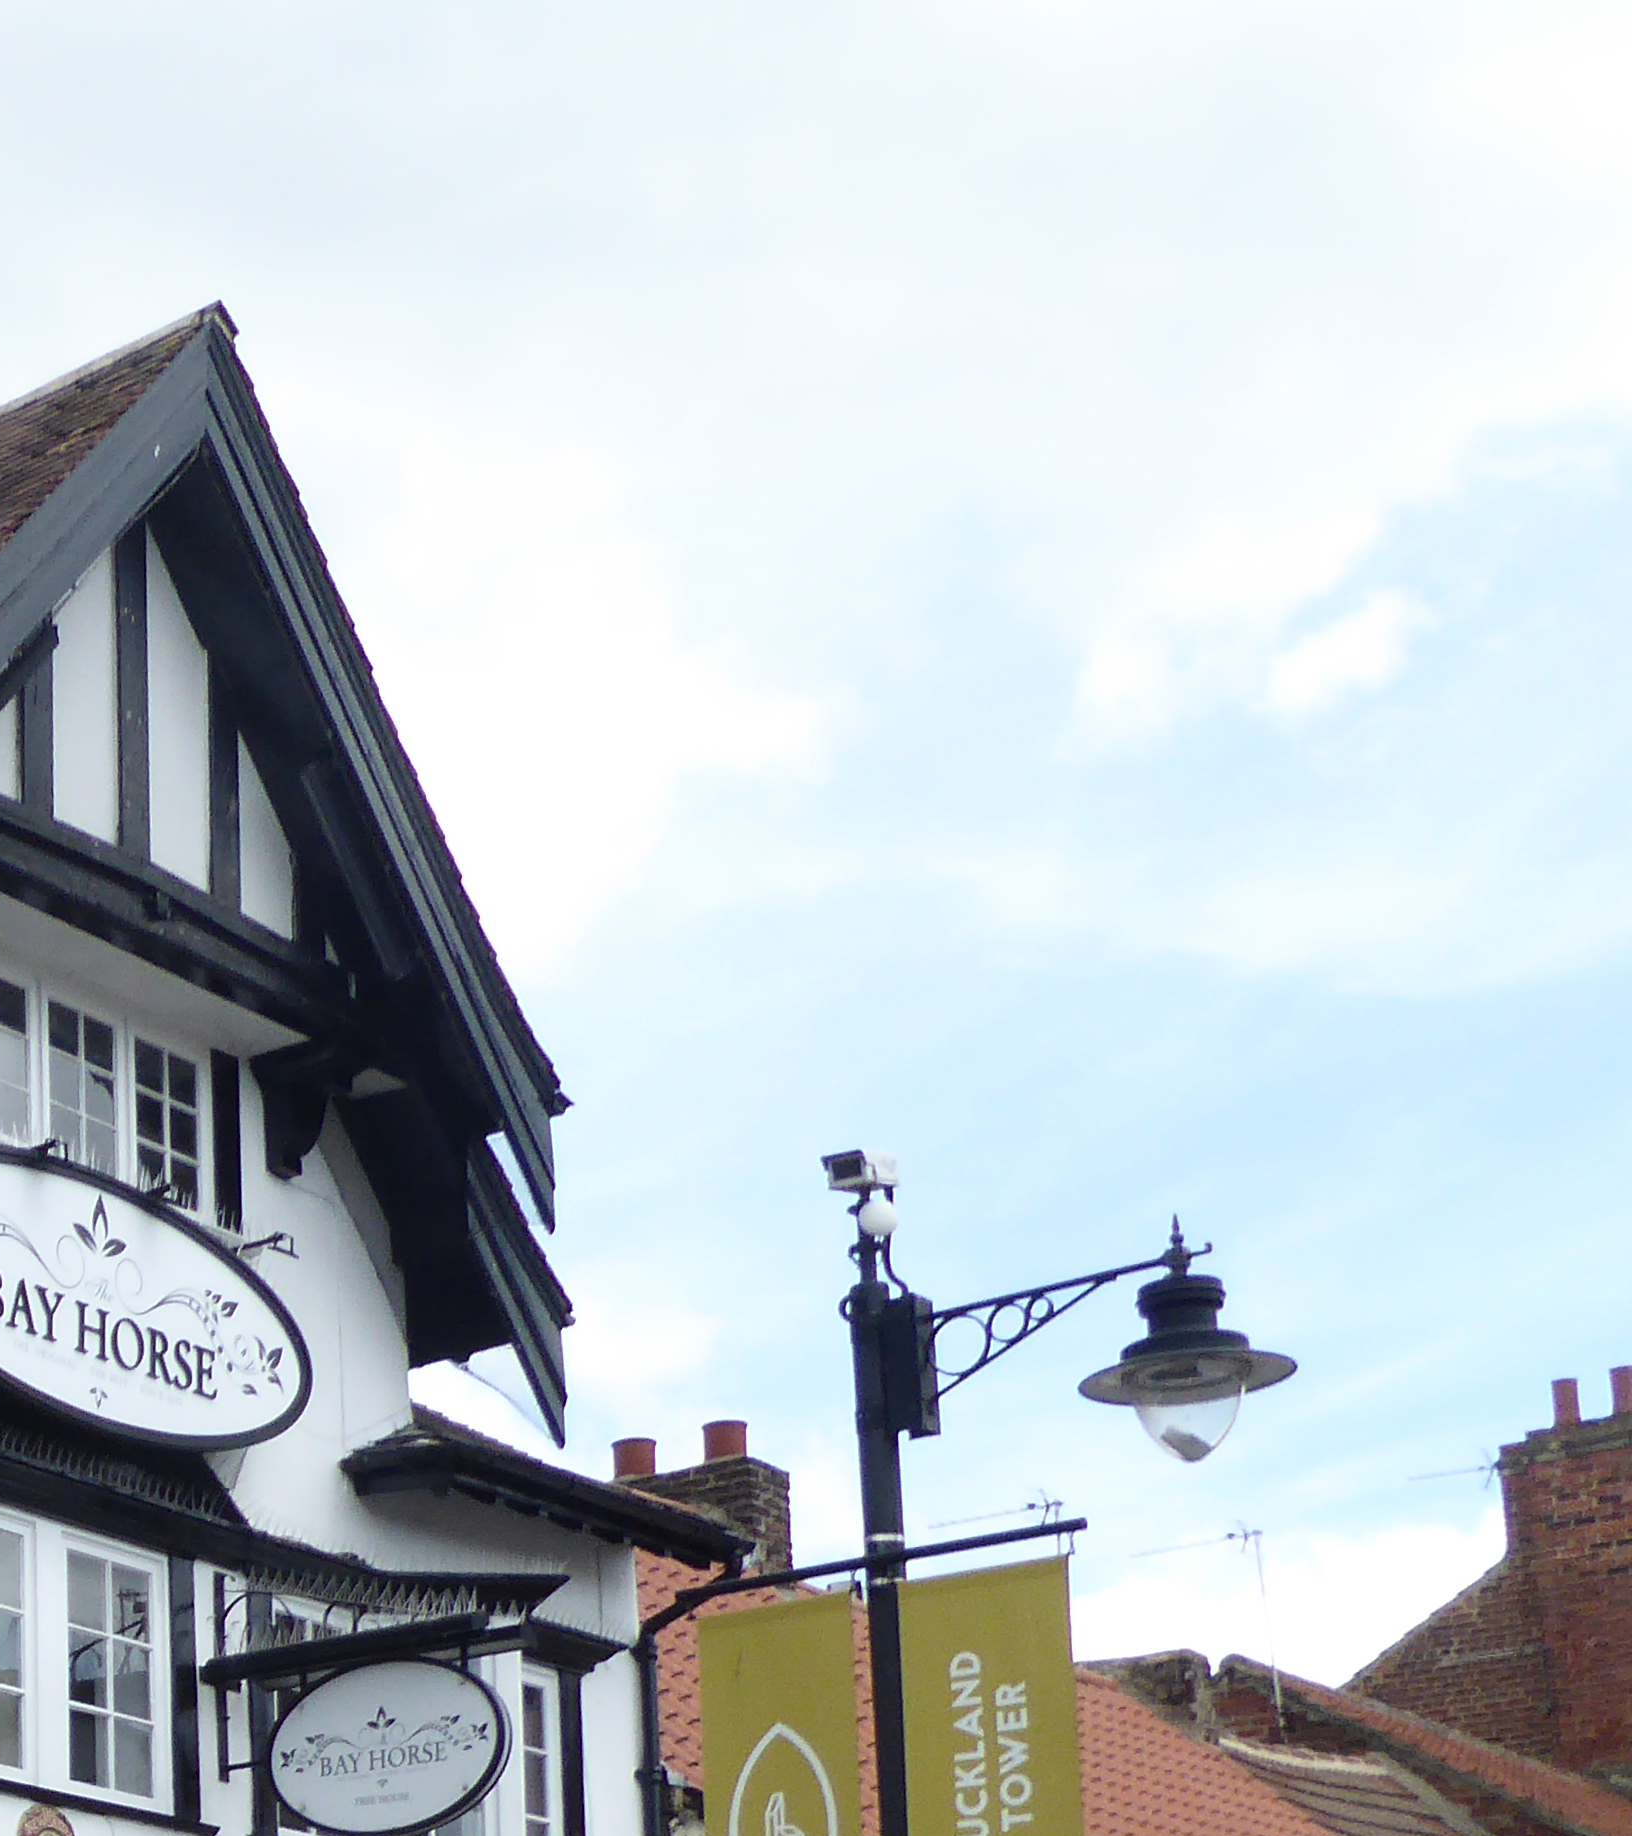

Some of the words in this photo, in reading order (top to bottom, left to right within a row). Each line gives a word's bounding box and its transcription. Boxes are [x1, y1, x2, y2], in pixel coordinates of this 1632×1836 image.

[73, 1300, 219, 1402] HORSE
[320, 1751, 362, 1777] BAY
[368, 1741, 448, 1771] HORSE
[995, 1680, 1034, 1833] TOWER
